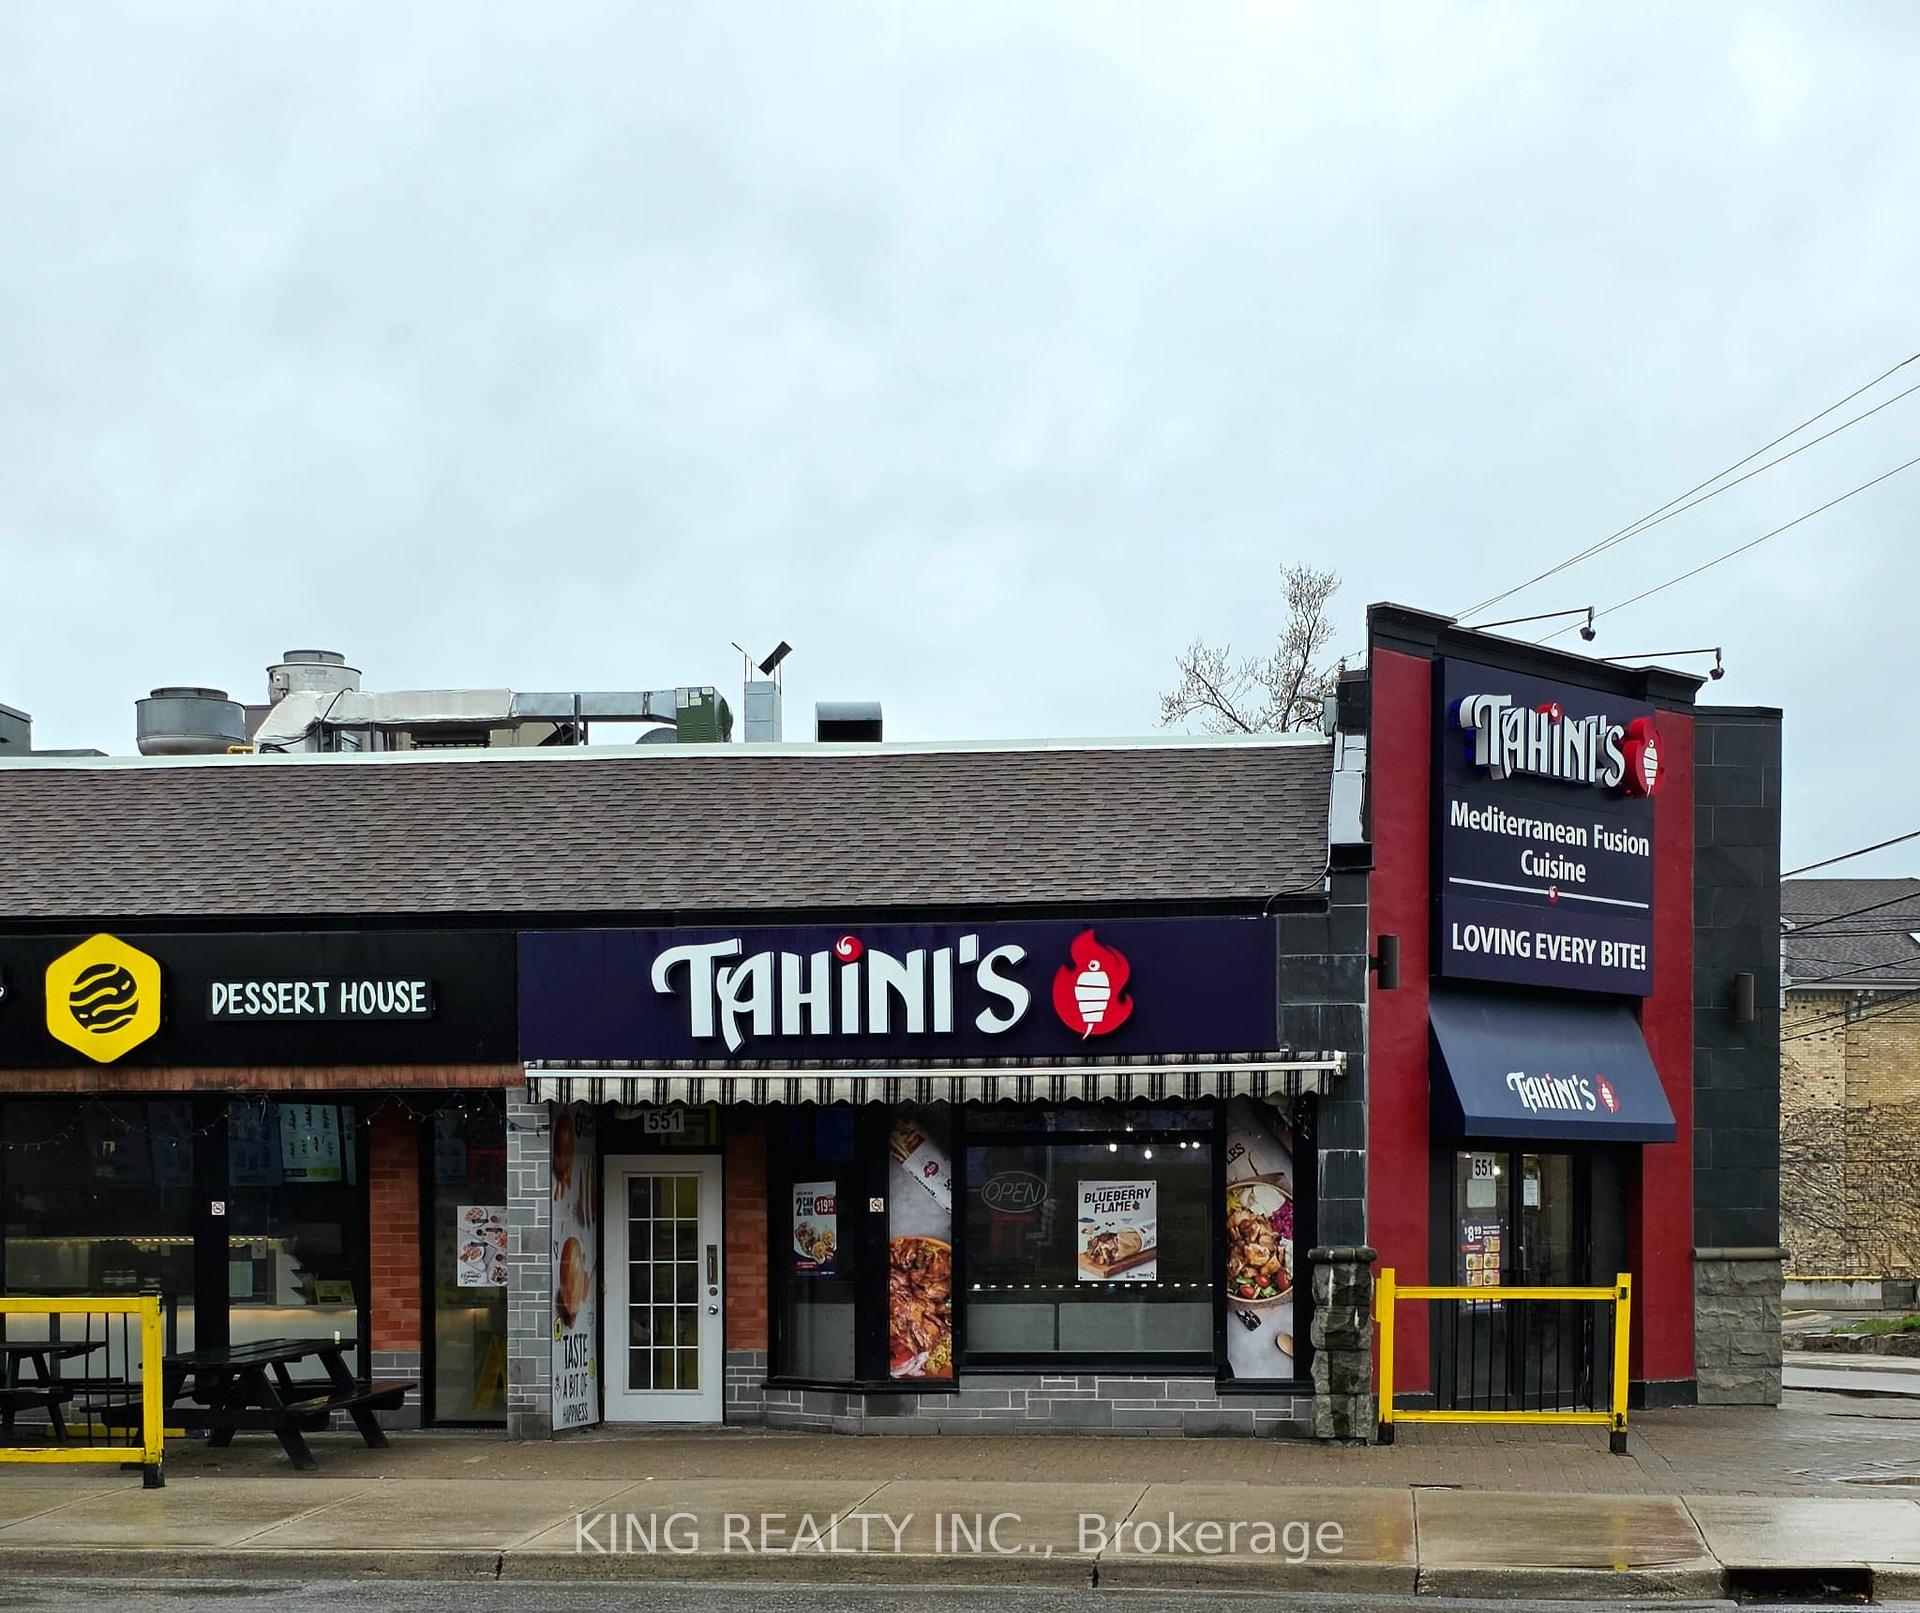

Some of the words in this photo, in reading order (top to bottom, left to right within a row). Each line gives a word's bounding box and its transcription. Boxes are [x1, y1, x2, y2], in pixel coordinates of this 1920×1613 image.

[1451, 800, 1588, 848] Mediterranean
[1594, 824, 1650, 857] Fusion
[1521, 850, 1587, 883] Cuisine
[1452, 922, 1531, 958] LOVING
[1535, 932, 1597, 964] EVERY
[1601, 940, 1647, 971] BITE!
[212, 981, 330, 1015] DESSERT
[340, 981, 427, 1014] HOUSE
[648, 1107, 680, 1131] 551
[1475, 1159, 1493, 1177] 551
[985, 1181, 1042, 1203] OPEN
[1084, 1187, 1152, 1204] BLUEBERRY
[1094, 1201, 1132, 1214] FLAME
[562, 1333, 589, 1370] TASTE
[569, 1373, 579, 1399] BIT
